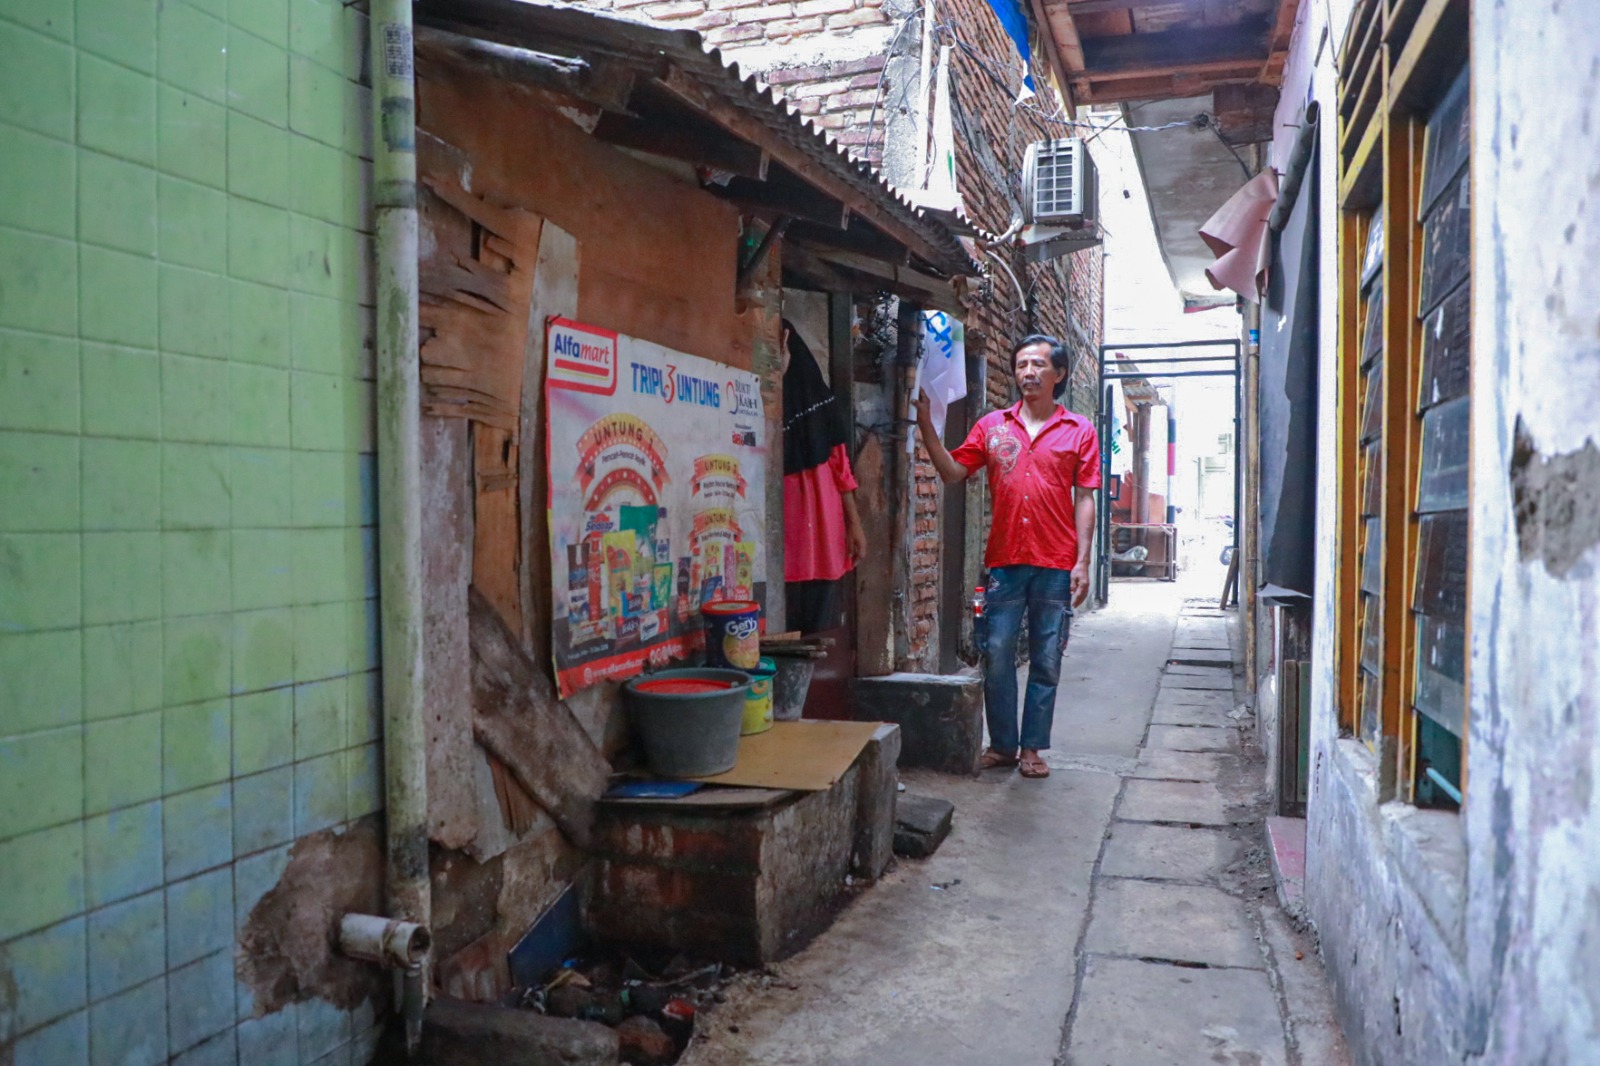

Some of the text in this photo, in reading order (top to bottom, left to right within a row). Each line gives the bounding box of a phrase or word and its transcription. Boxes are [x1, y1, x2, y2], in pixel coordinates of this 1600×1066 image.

[554, 333, 610, 364] Alfamart
[677, 373, 720, 408] UNTUNG
[594, 421, 643, 445] UNTUNG
[704, 459, 731, 471] UNTUNG
[725, 617, 758, 640] Gery
